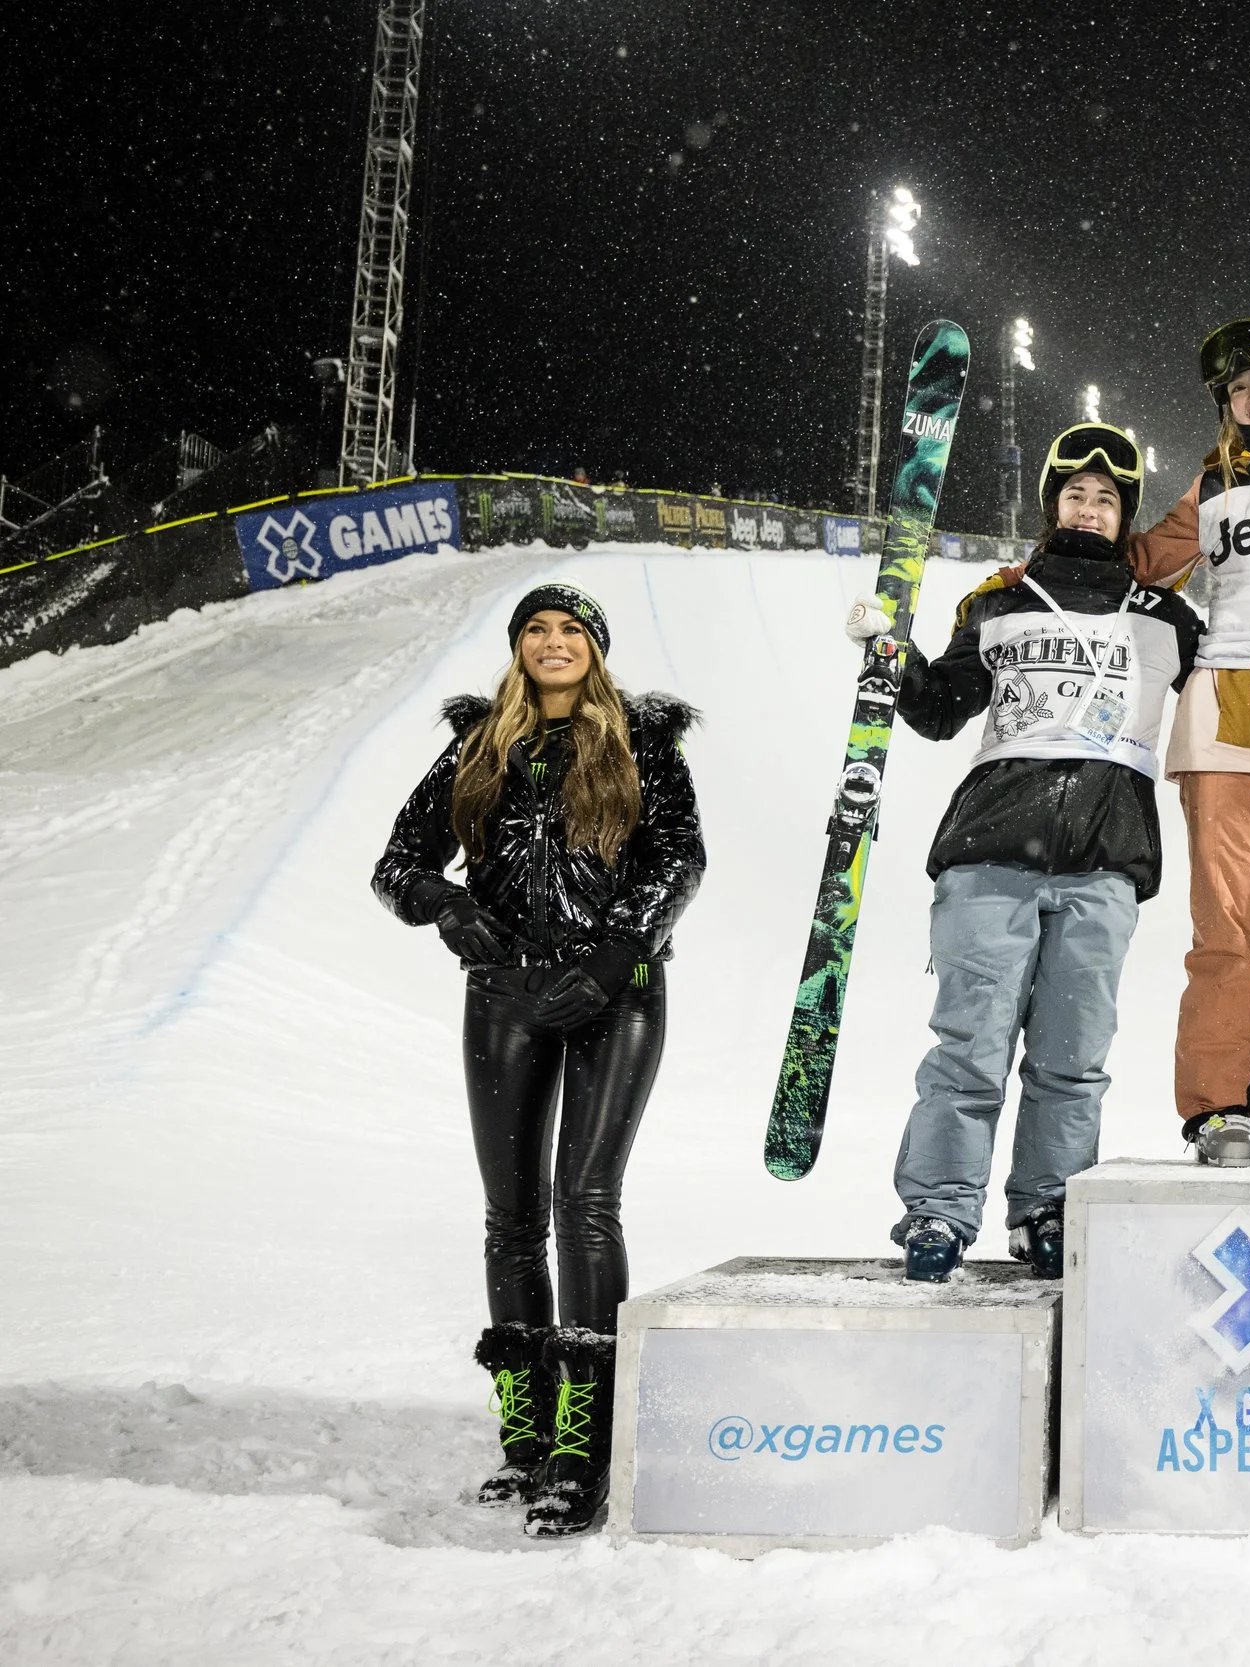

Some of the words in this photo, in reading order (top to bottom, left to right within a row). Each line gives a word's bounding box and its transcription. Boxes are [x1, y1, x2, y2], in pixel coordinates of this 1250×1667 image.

[902, 412, 951, 442] ZUMA
[329, 498, 452, 560] GAMES
[1193, 1386, 1219, 1433] X
[709, 1415, 946, 1461] @xgames
